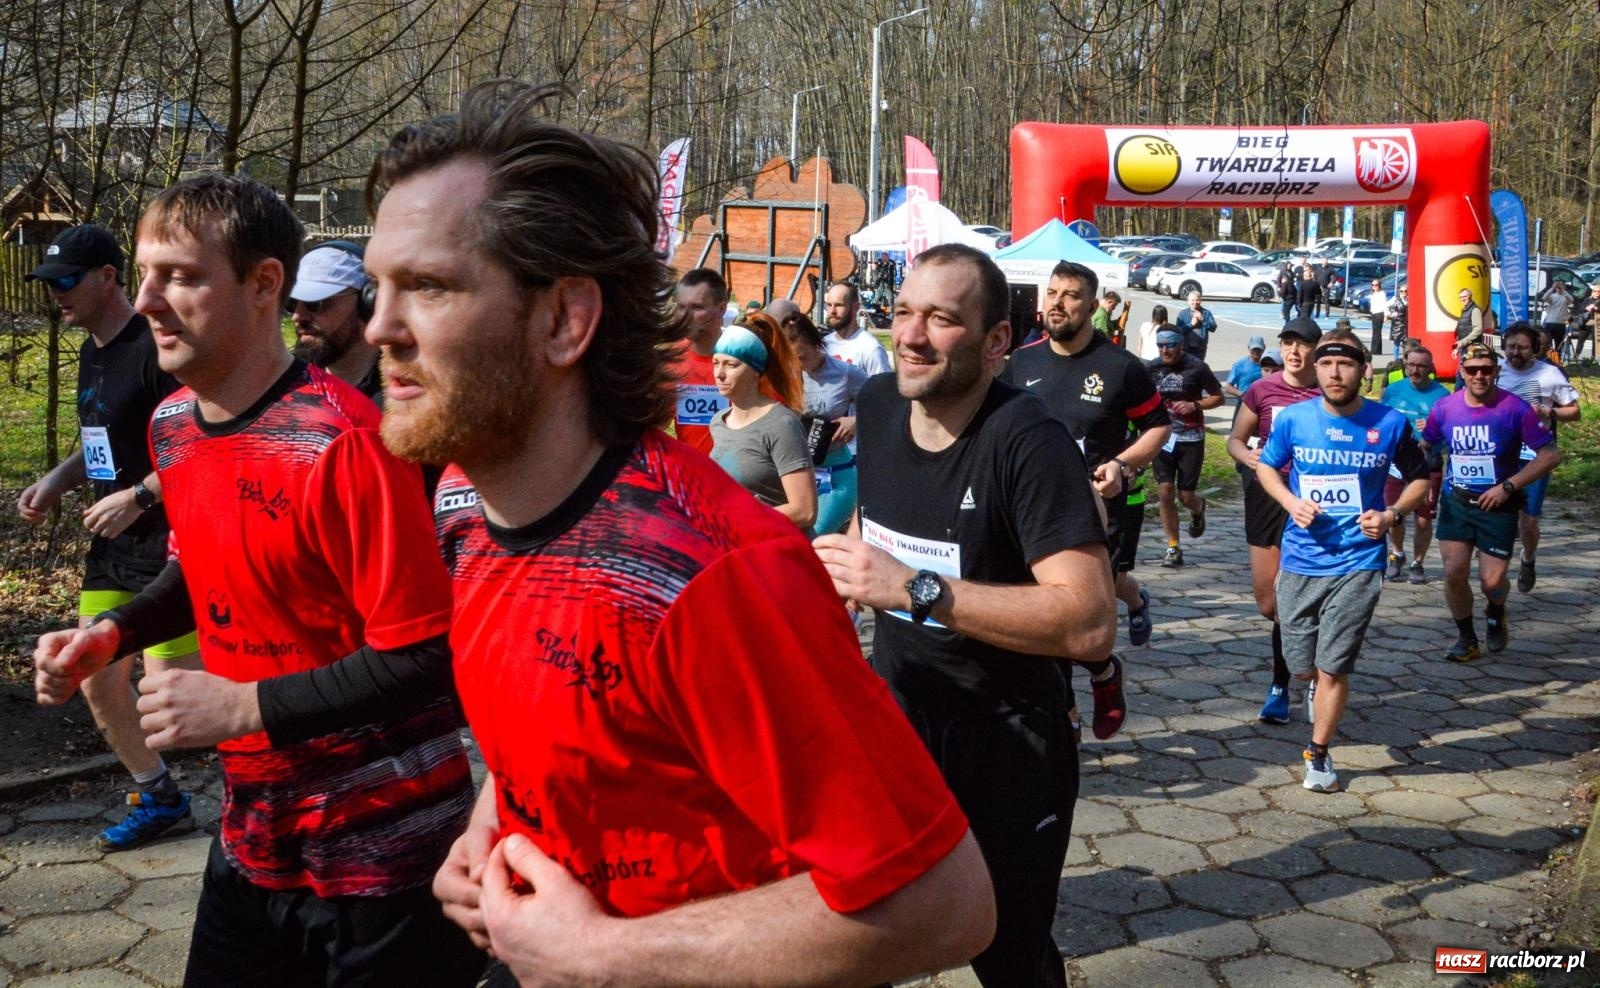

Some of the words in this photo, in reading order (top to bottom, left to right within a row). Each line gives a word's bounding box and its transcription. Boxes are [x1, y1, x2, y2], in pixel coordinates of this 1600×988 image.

[1238, 136, 1290, 149] BIEG
[1194, 157, 1337, 173] TWARDZIELA
[1206, 177, 1320, 196] RACIBÓRZ
[685, 398, 720, 414] 024
[1452, 425, 1489, 450] RUN
[86, 445, 107, 465] 045
[1293, 446, 1388, 468] RUNNERS
[1460, 465, 1485, 477] 091
[1310, 488, 1350, 504] 040
[896, 539, 950, 558] TWARDZIELA
